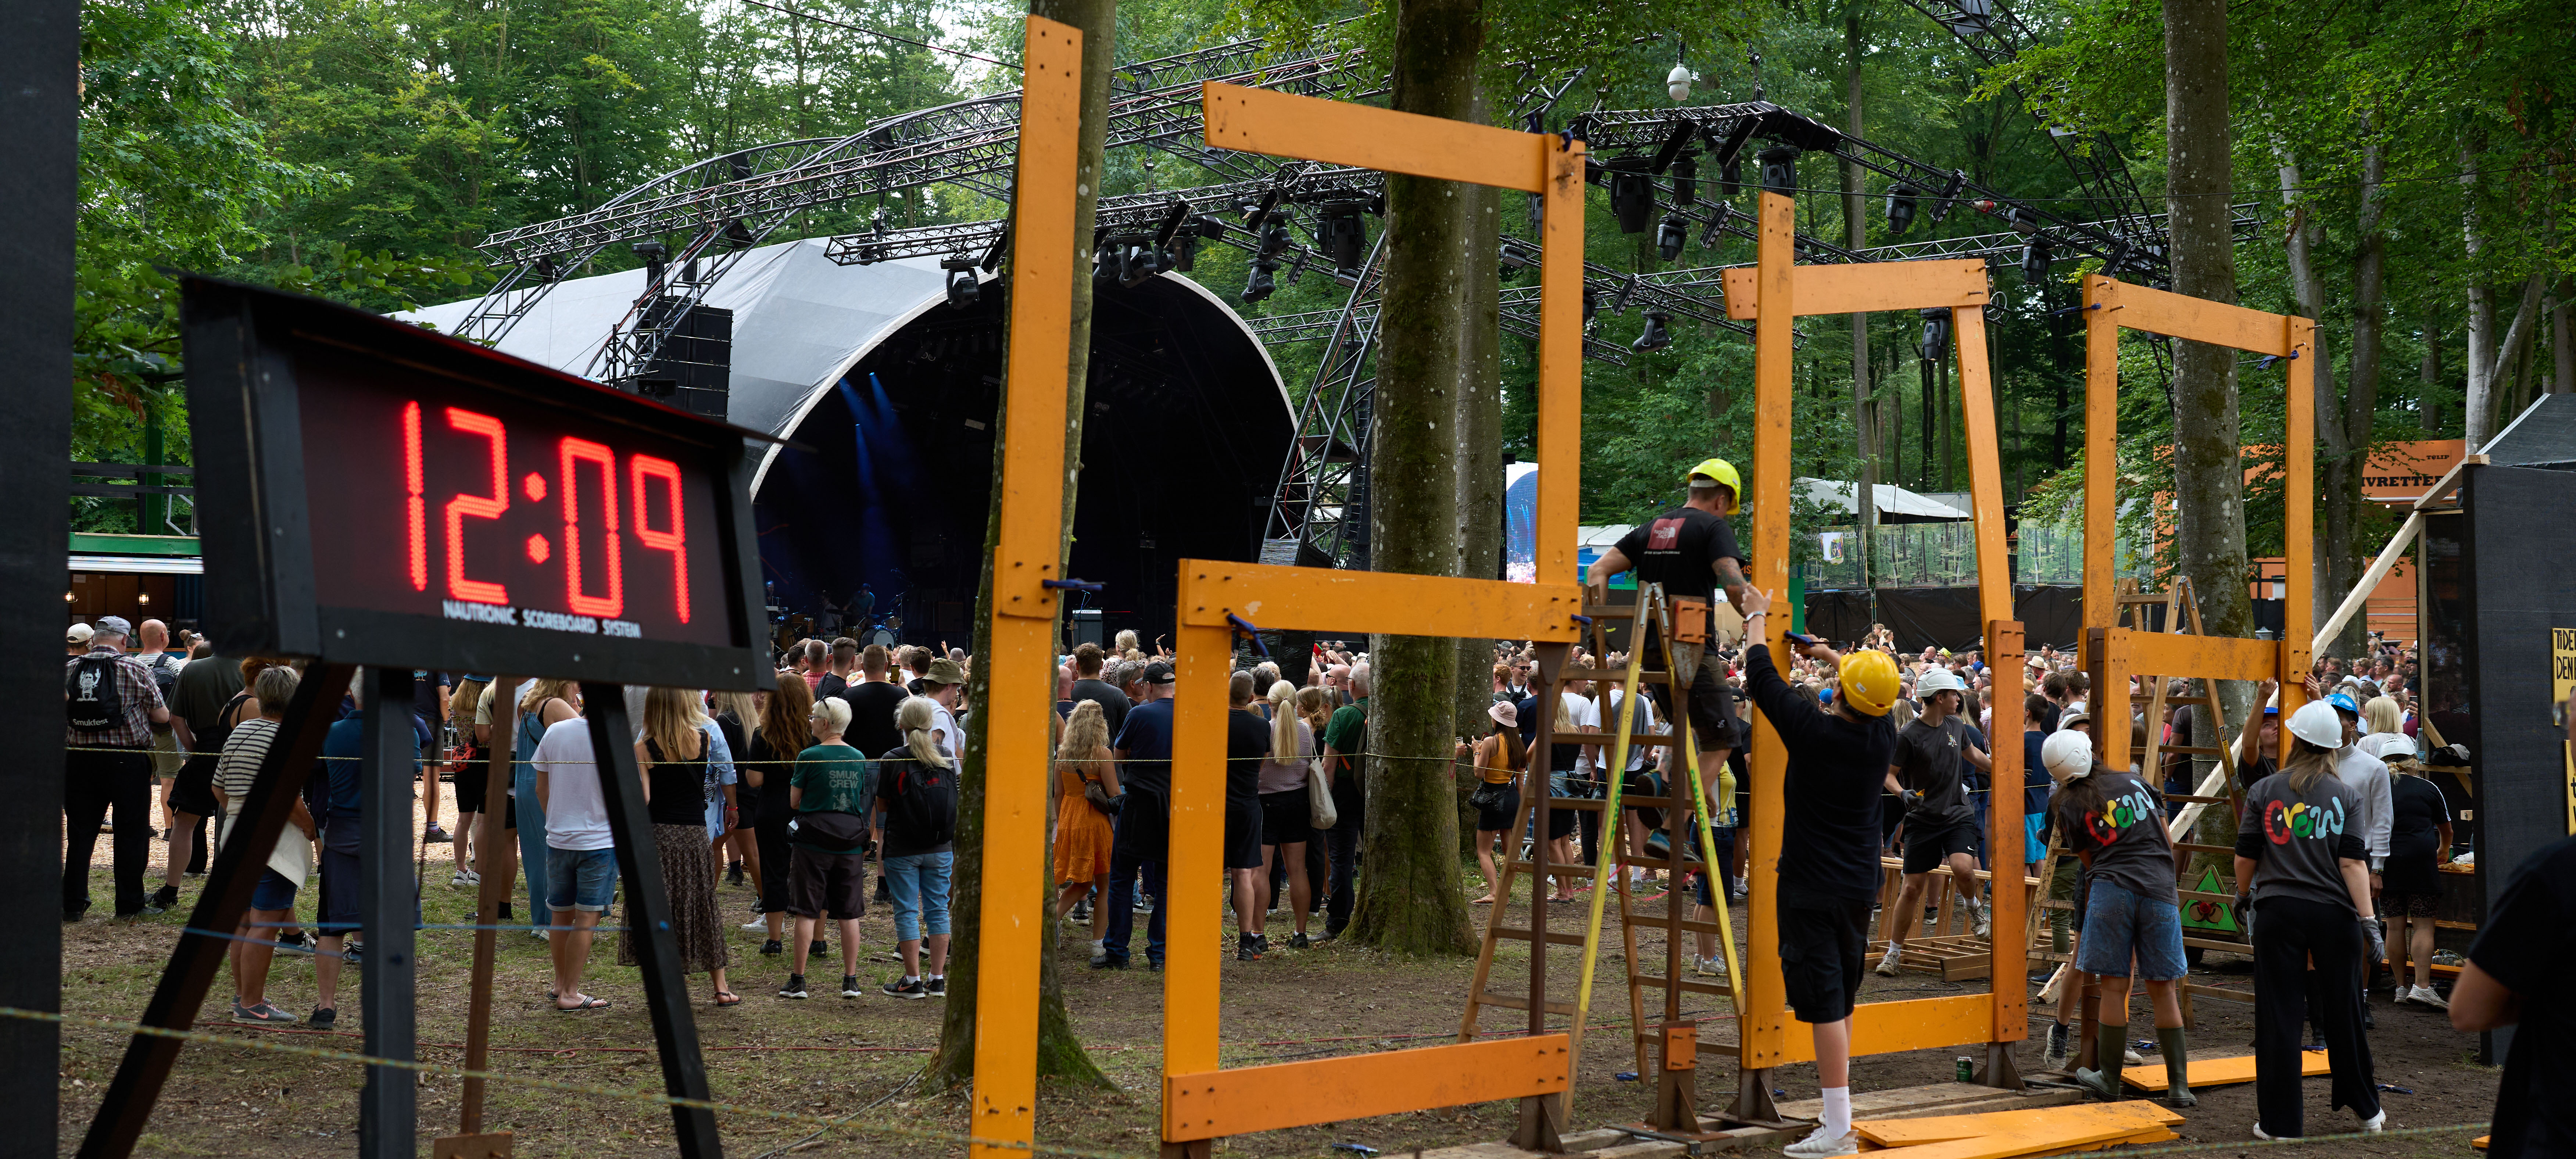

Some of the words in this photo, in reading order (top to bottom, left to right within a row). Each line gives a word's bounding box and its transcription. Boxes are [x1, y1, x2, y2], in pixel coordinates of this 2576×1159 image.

[405, 401, 690, 624] 12:09
[443, 599, 518, 625] NAUTRONIC
[522, 609, 598, 634] SCOREBOARD
[602, 619, 642, 639] SYSTEM
[829, 770, 858, 781] SMUK
[829, 779, 859, 789] CREW
[2264, 796, 2344, 845] Crew
